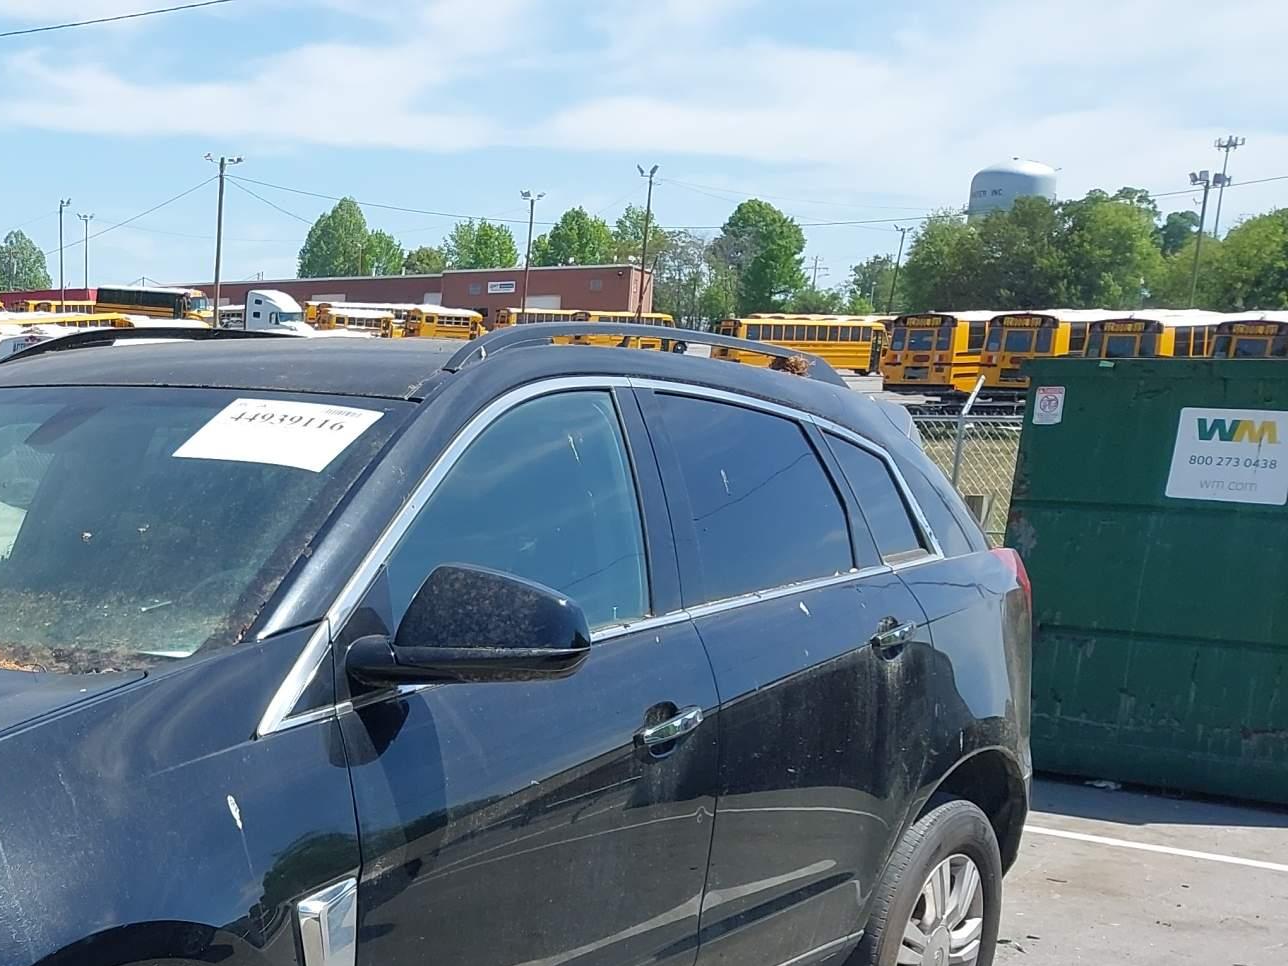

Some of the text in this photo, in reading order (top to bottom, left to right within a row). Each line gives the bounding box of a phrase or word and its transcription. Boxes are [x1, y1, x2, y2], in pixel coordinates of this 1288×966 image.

[230, 411, 345, 432] 44939116
[1197, 417, 1277, 444] WM
[1188, 455, 1278, 469] 800 273 0438
